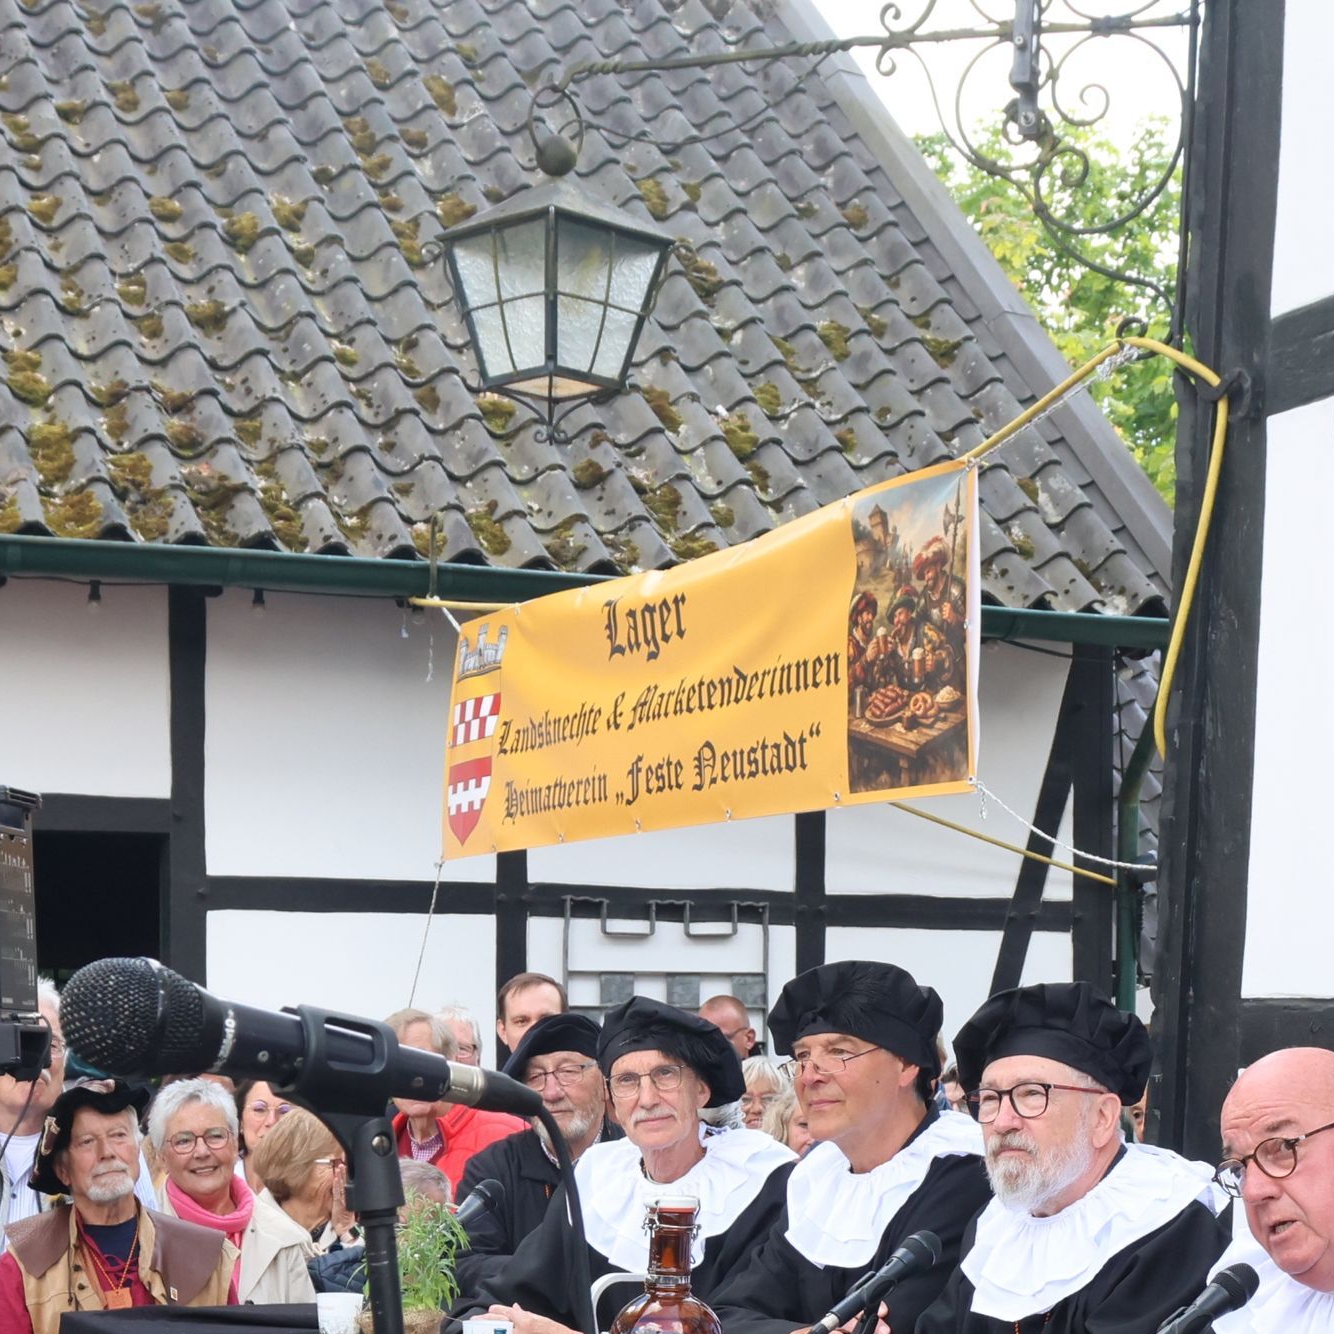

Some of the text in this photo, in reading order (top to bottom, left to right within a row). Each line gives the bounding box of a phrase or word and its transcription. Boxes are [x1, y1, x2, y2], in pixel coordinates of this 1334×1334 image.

[601, 591, 687, 662] Lager
[497, 651, 841, 757] Landsknechte & Marketenderinnen
[502, 764, 608, 825] Heimatverein
